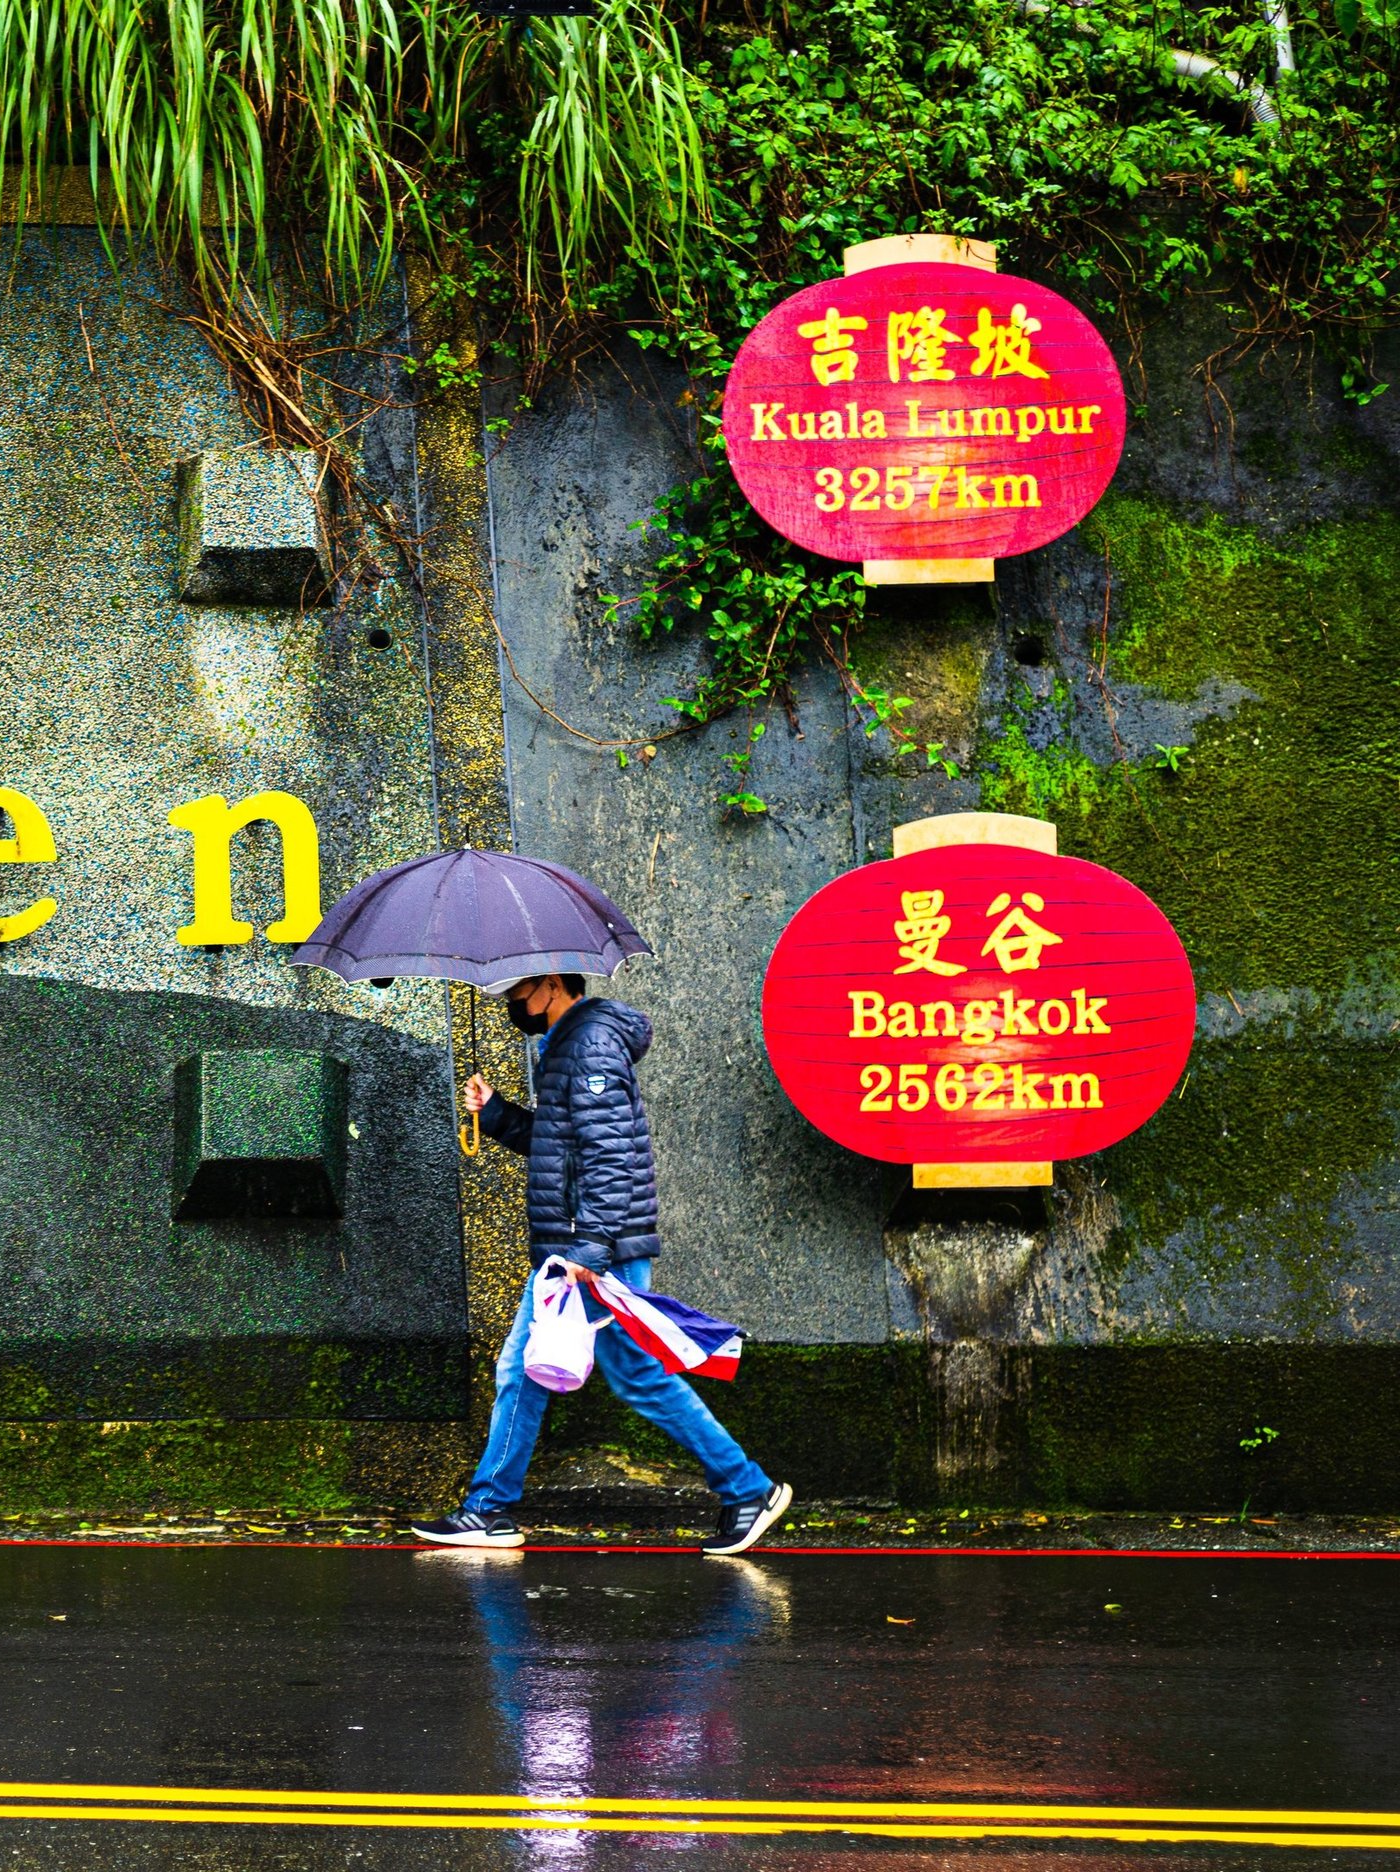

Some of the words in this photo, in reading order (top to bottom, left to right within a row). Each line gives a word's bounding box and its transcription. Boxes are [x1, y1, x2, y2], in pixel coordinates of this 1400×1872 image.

[797, 303, 1051, 387] 吉隆坡
[750, 401, 888, 441] Kuala
[906, 399, 1102, 442] Lumpur
[814, 464, 1042, 512] 3257km
[892, 888, 1064, 977] 曼谷
[847, 987, 1112, 1046] Bangkok
[858, 1062, 1104, 1112] 2562km
